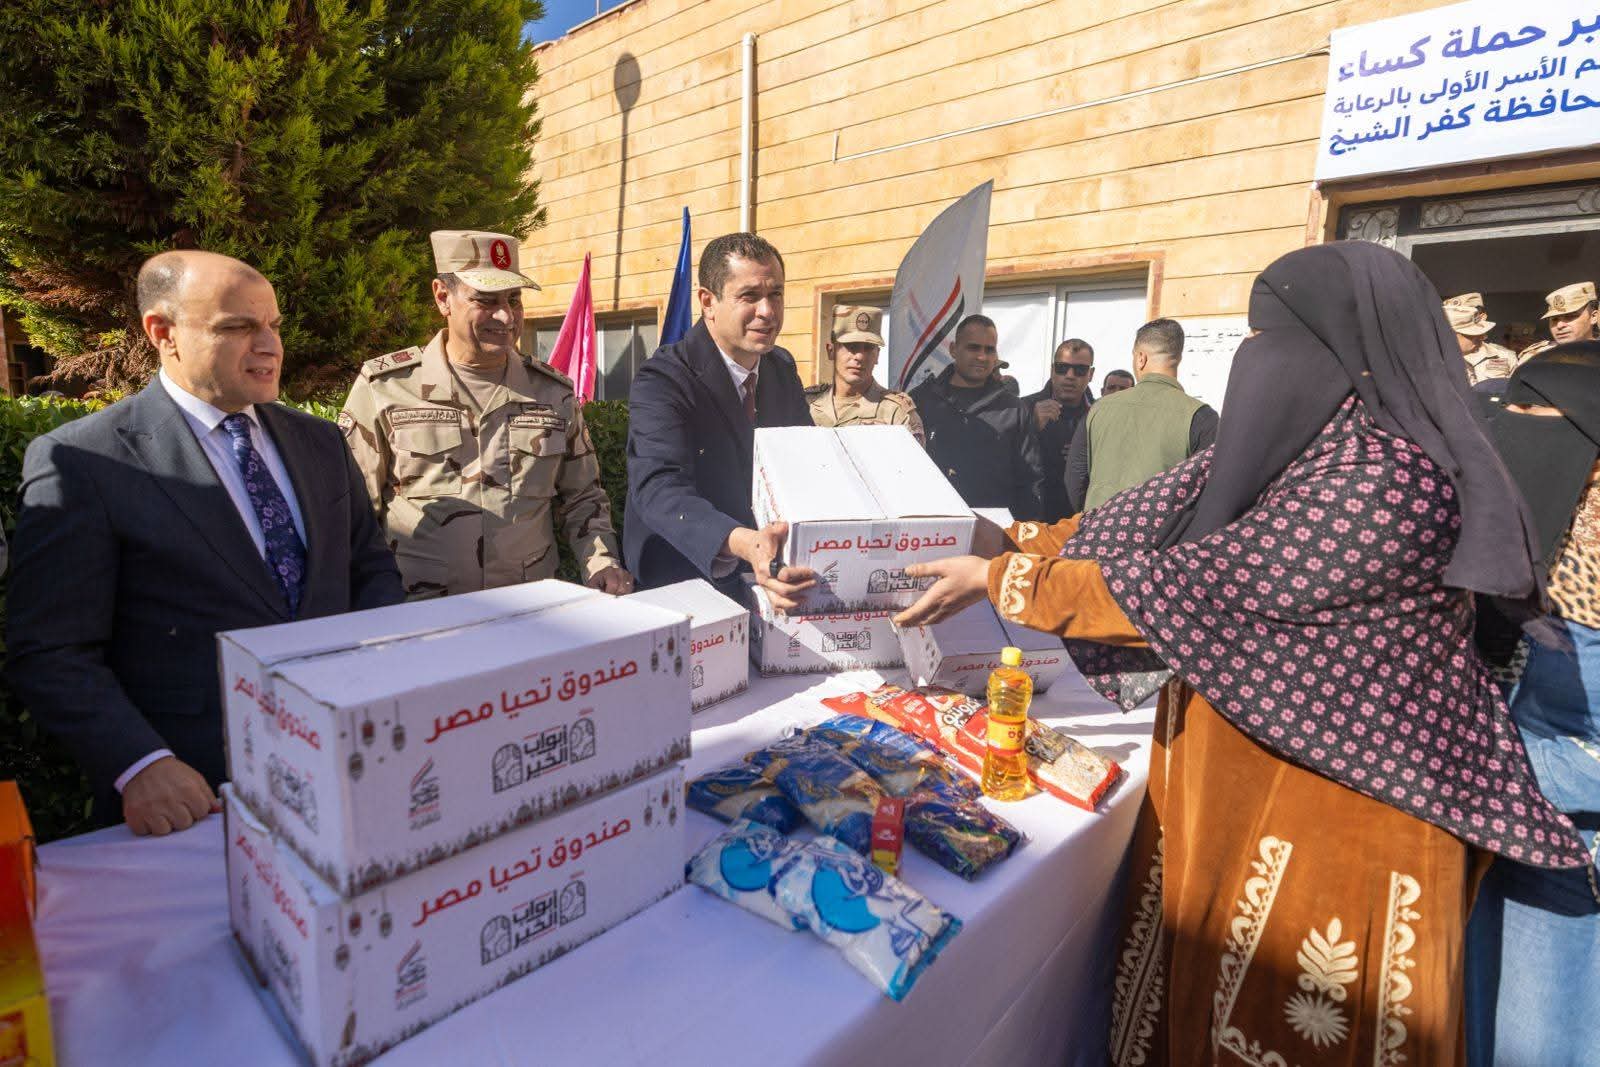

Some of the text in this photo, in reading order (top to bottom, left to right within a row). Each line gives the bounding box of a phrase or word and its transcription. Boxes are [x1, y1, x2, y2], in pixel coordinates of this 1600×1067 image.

[1337, 14, 1600, 82] بر حملة كساء
[1420, 70, 1489, 105] الأولى
[1495, 56, 1567, 92] الأسر
[1333, 87, 1411, 118] بالرعاية
[1328, 88, 1600, 156] حافظة كفر الشيخ
[809, 533, 957, 553] صندوق تحيا مصر
[889, 579, 918, 593] الخير
[424, 659, 639, 744] صندوق تحيا مصر
[525, 746, 568, 783] الخير
[411, 818, 632, 928] صندوق تحيا مصر
[512, 911, 557, 950] الخير
